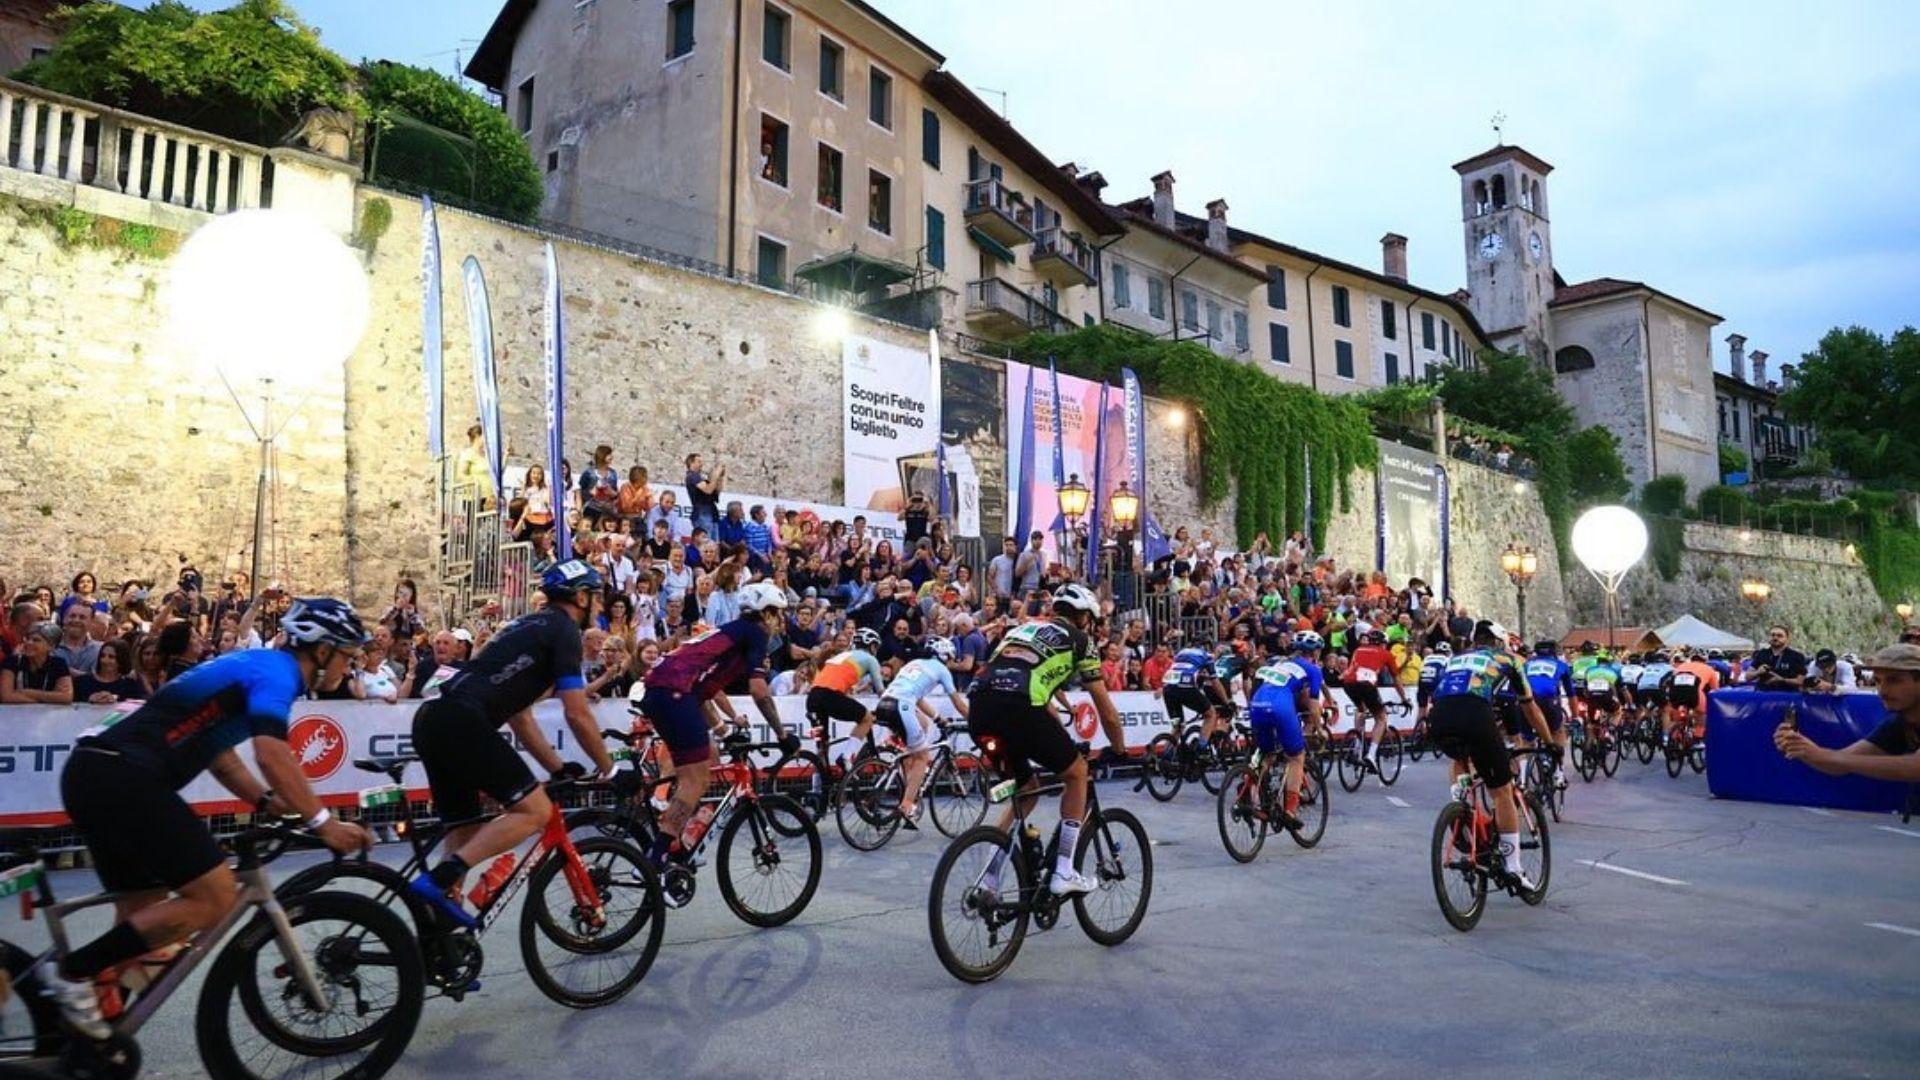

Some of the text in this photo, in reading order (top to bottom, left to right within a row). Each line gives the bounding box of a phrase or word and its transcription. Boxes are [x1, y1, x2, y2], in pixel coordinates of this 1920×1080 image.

[850, 383, 926, 413] Scopri Feltre
[850, 403, 924, 429] con un unico
[850, 416, 898, 440] biglietto
